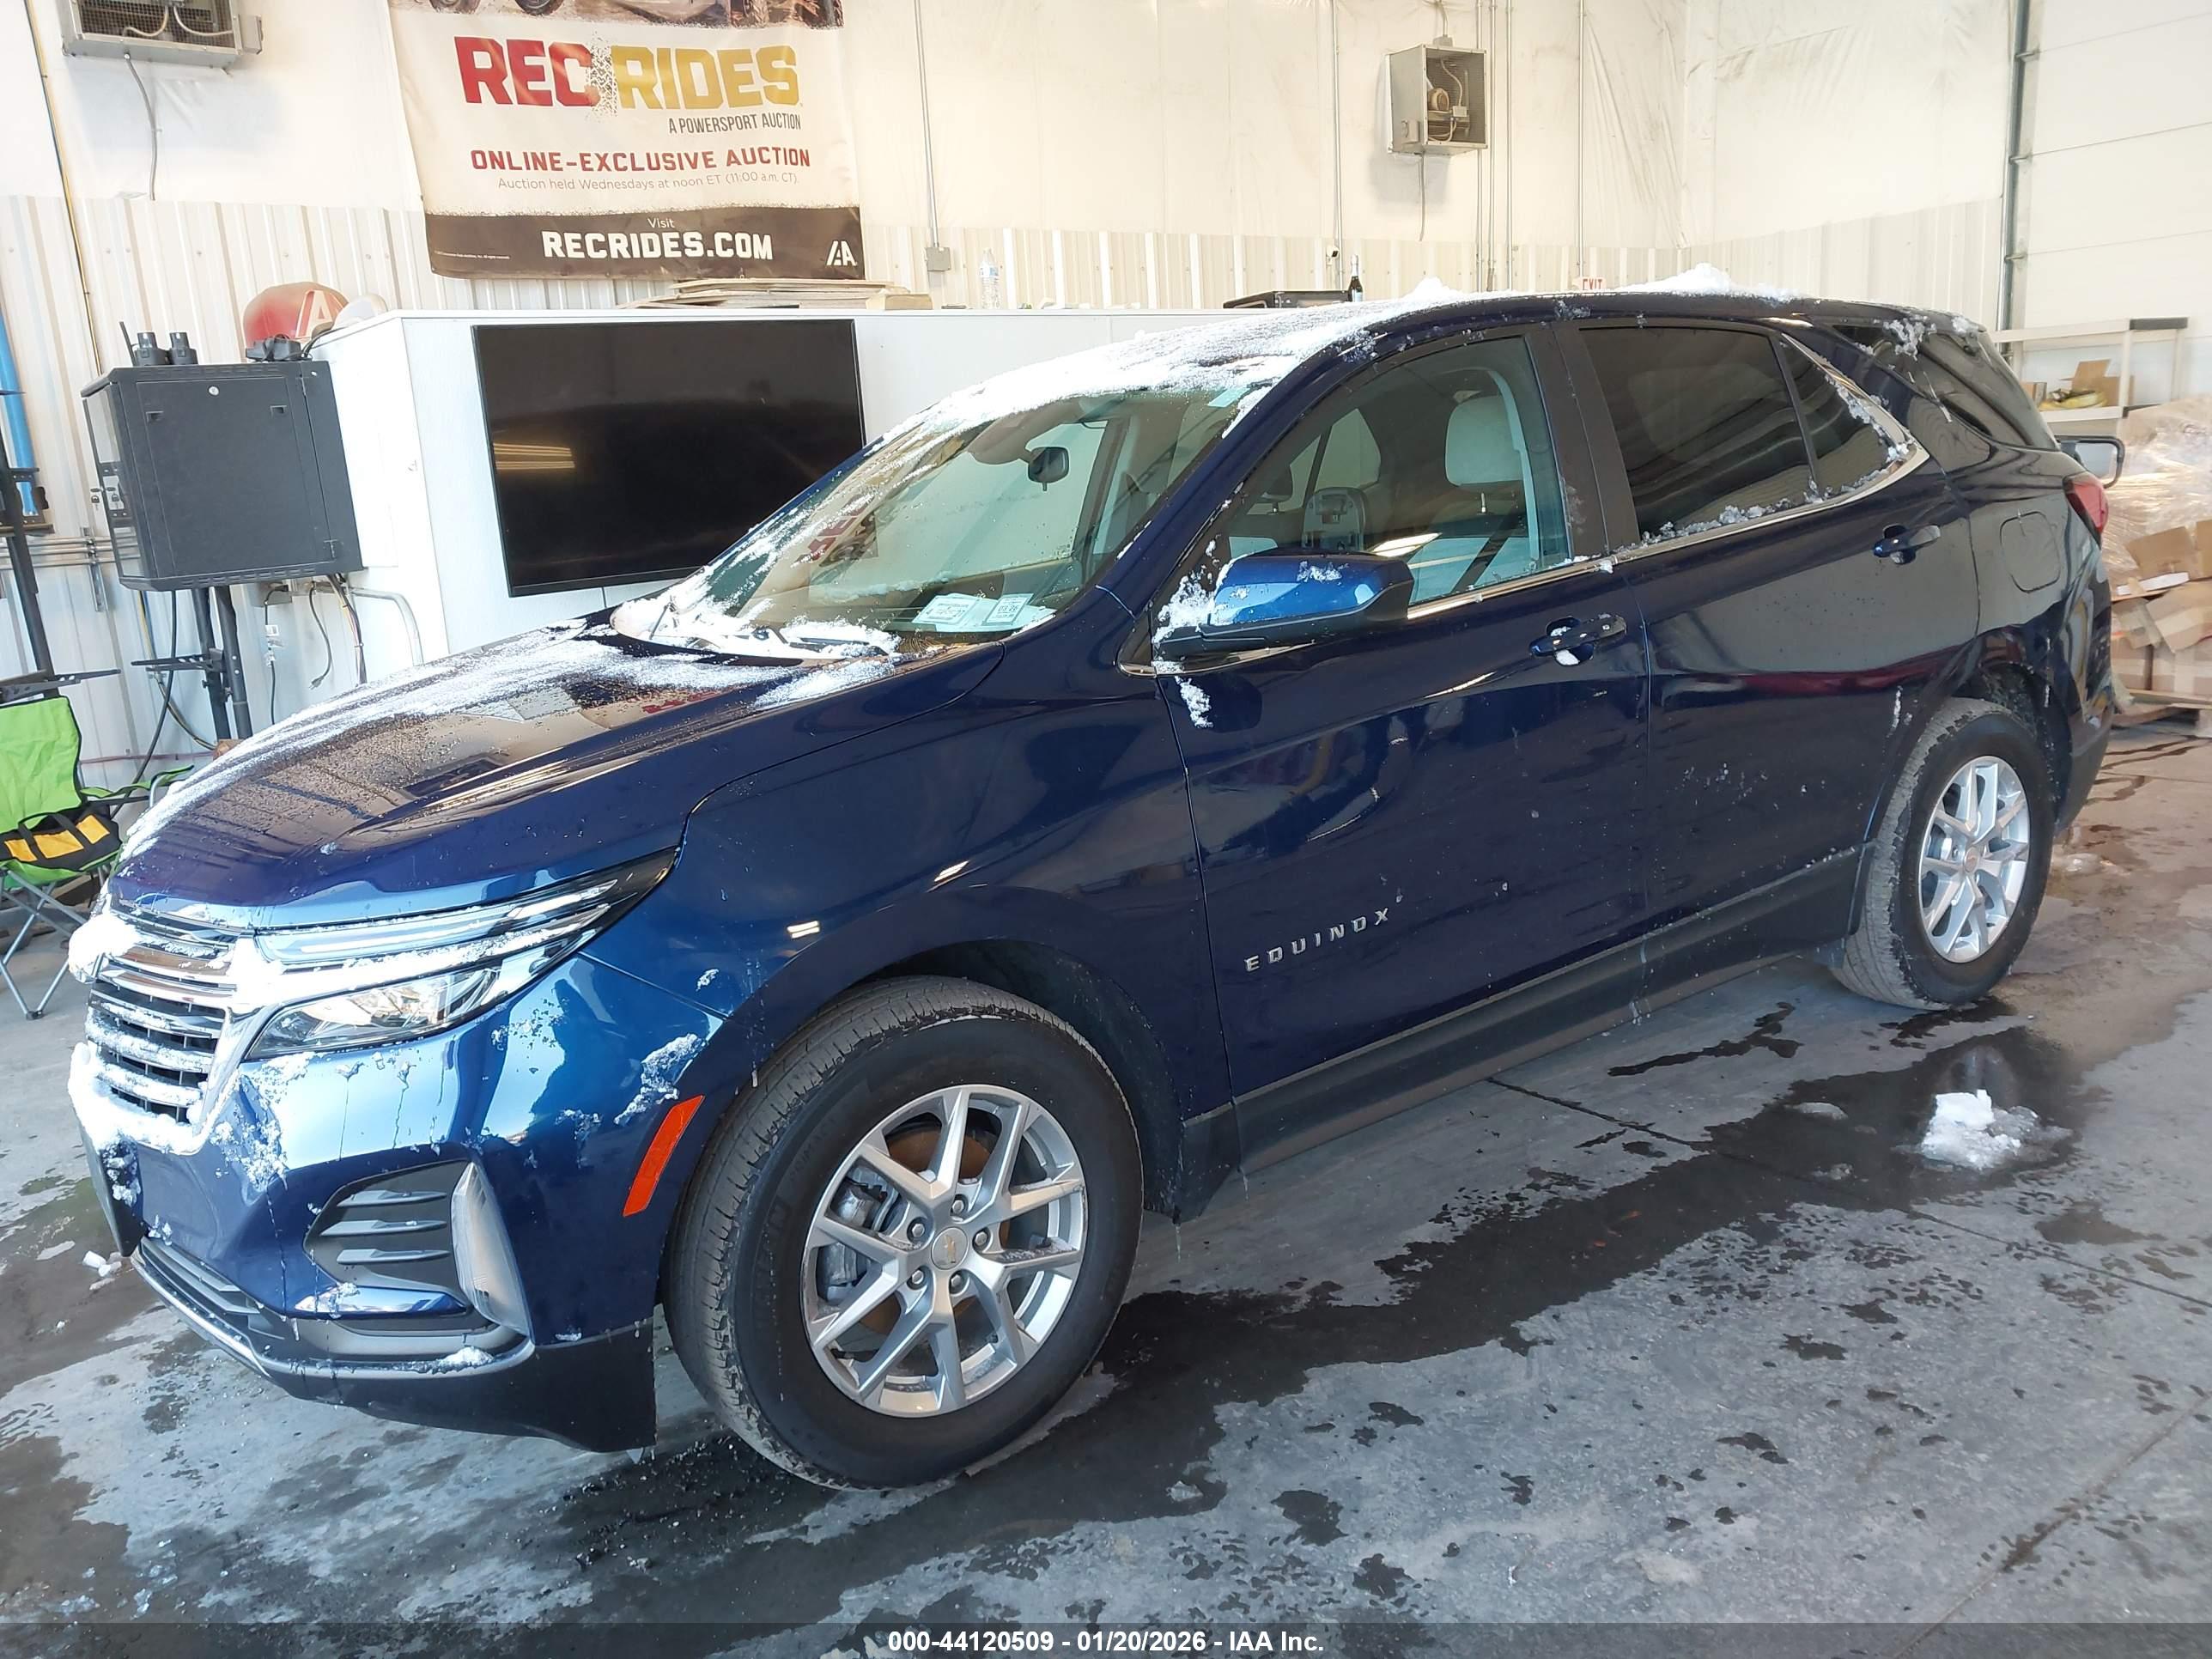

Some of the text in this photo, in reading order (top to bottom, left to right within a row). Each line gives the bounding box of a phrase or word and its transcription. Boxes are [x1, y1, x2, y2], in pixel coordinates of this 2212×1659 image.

[453, 36, 801, 110] REC RIDES
[668, 112, 802, 134] A POWERSPORT AUCTION
[470, 146, 811, 173] ONLINE-EXCLUSIVE AUCTION
[498, 178, 546, 190] Auction
[549, 178, 575, 190] held
[578, 178, 654, 192] Wednesdays
[658, 179, 670, 189] at
[672, 176, 703, 187] noon
[706, 174, 722, 185] ET
[725, 171, 758, 185] (11:00
[647, 216, 676, 229] Visit
[541, 230, 773, 260] RECRIDES.COM
[1243, 907, 1389, 972] EQUINOX
